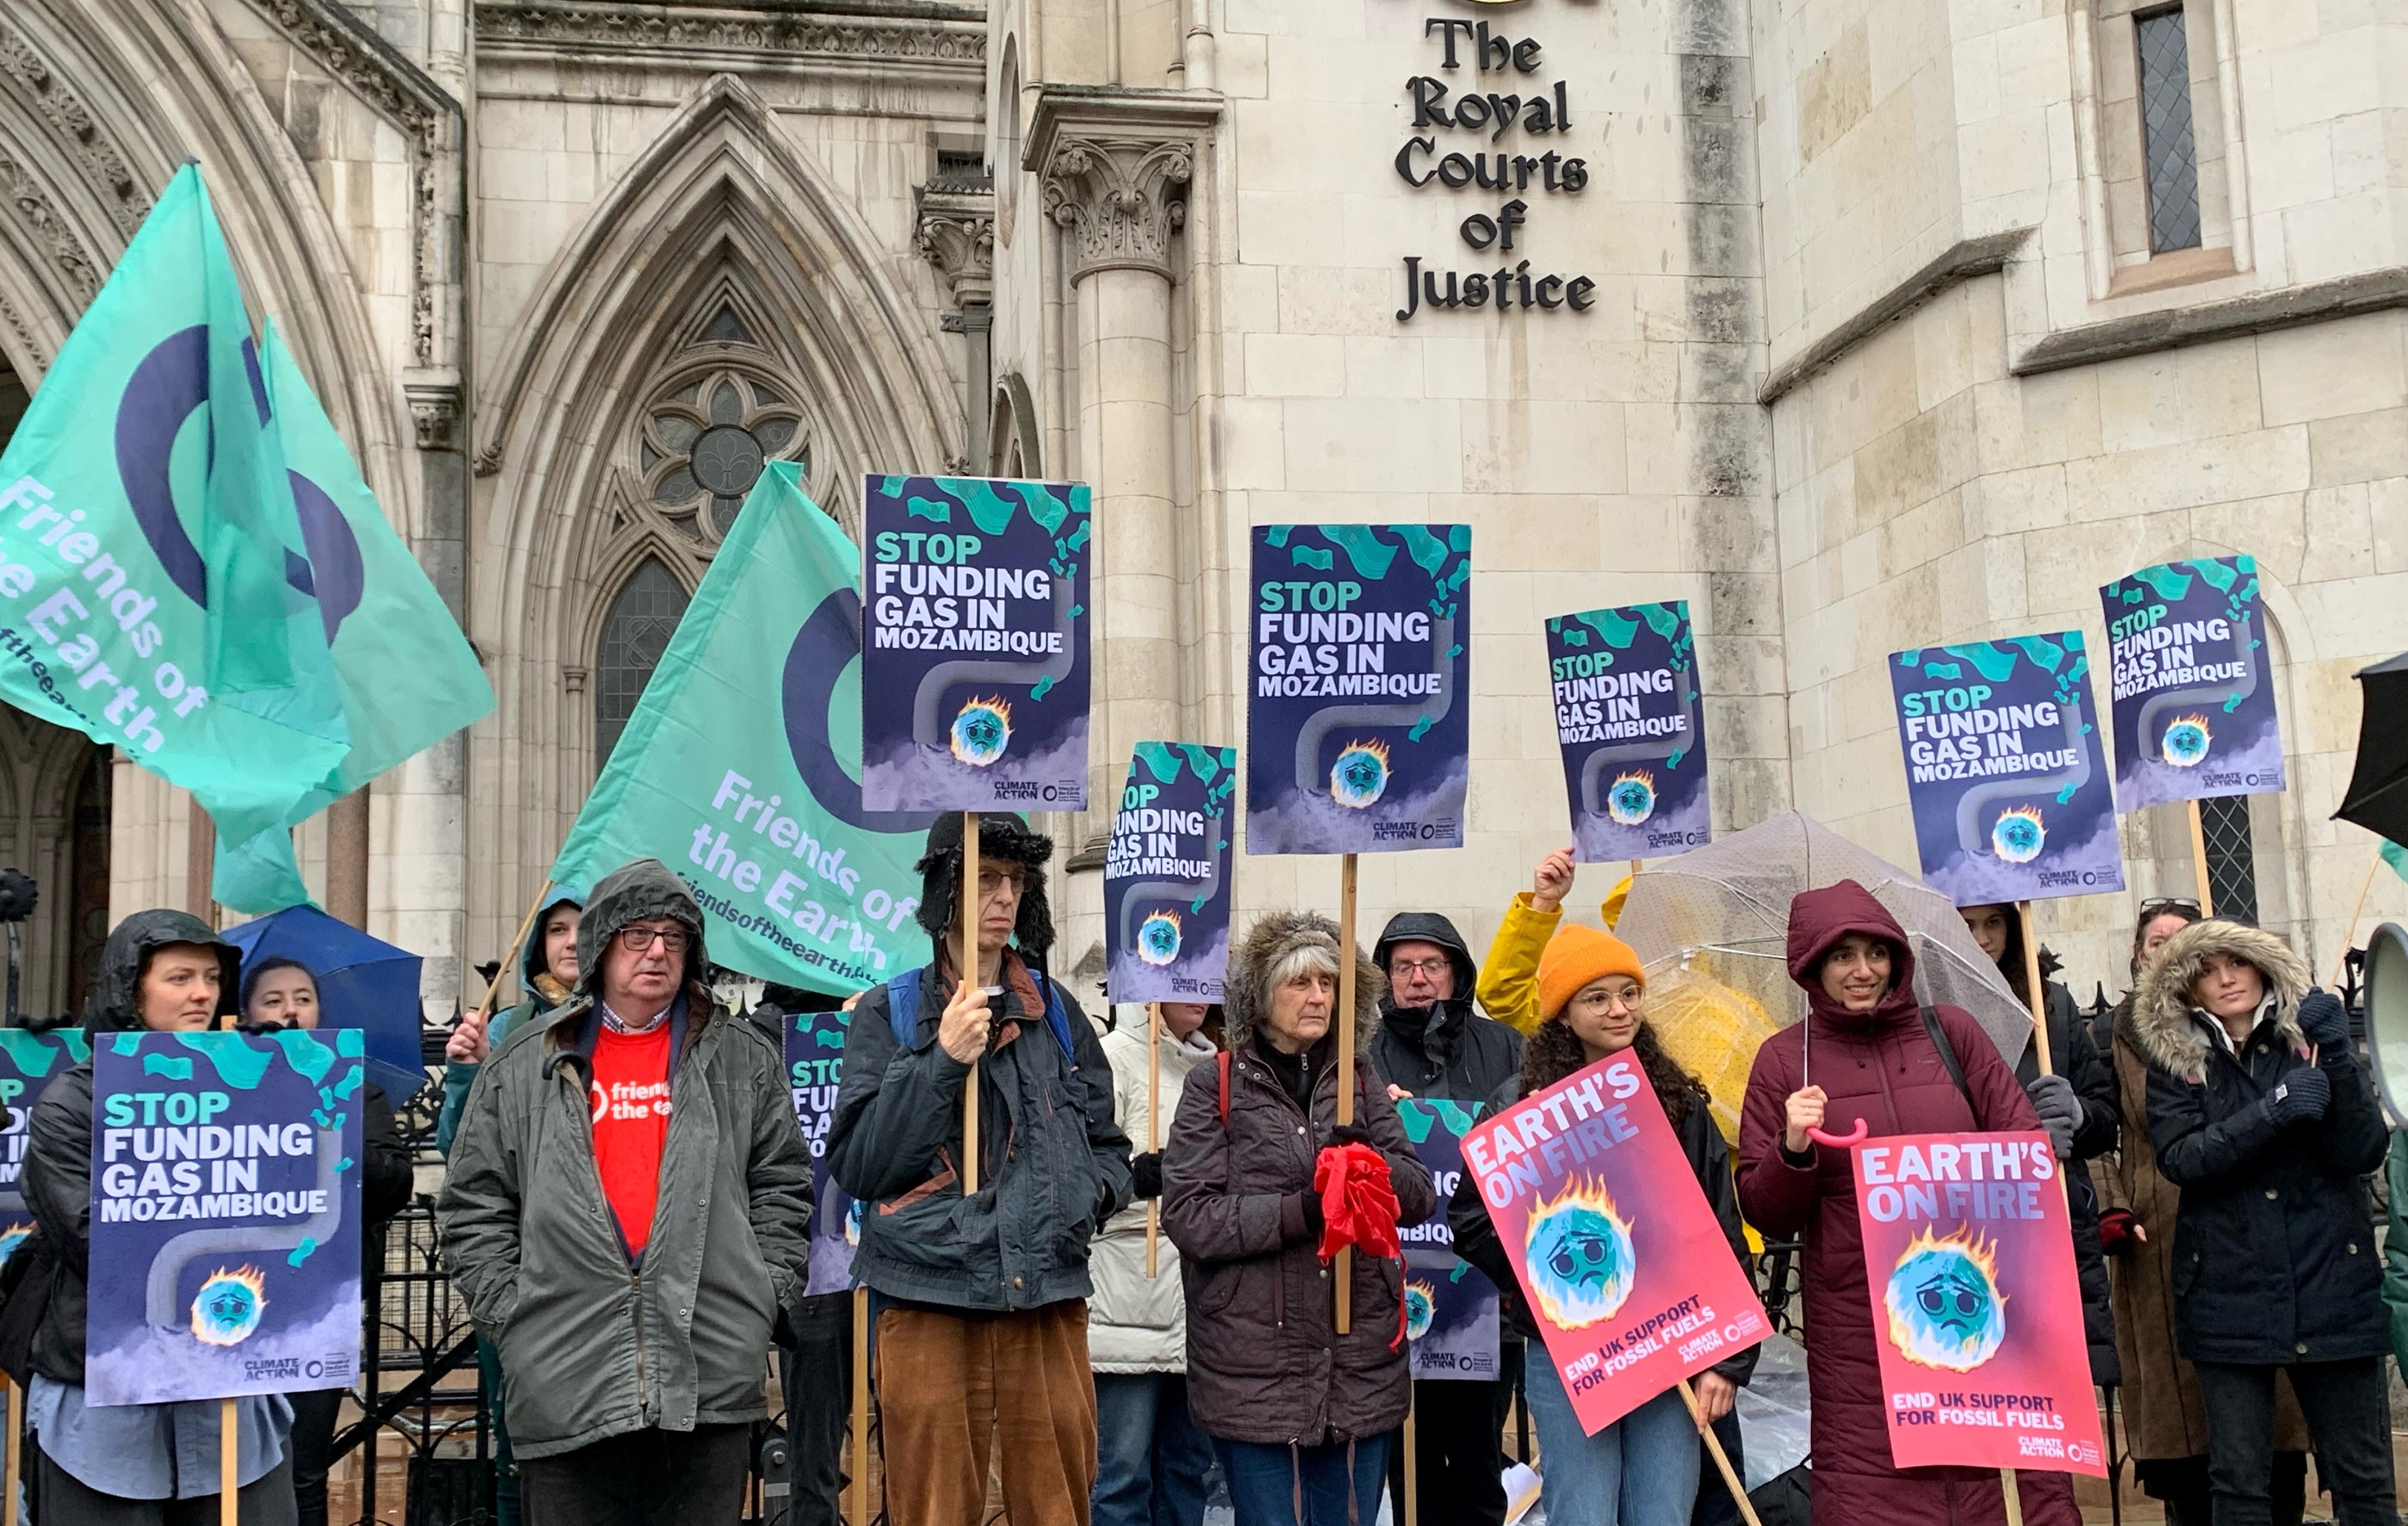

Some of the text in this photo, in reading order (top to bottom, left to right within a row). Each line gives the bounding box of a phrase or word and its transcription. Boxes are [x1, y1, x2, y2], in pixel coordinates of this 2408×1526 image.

[1426, 18, 1542, 73] The
[1406, 76, 1573, 143] Royal
[1395, 136, 1589, 191] Courts
[1460, 199, 1528, 249] of
[1396, 256, 1597, 321] Justice
[875, 532, 981, 565] STOP
[0, 475, 210, 719] Friends of
[875, 564, 1050, 600] FUNDING
[1259, 582, 1361, 612] STOP
[875, 597, 1005, 630] GAS IN
[1259, 612, 1429, 644] FUNDING
[2111, 604, 2167, 643] STOP
[875, 628, 1063, 655] MOZAMBIQUE
[2113, 619, 2230, 665] FUNDING
[26, 586, 164, 752] Earth
[1259, 644, 1384, 675] GAS IN
[1553, 651, 1614, 681] STOP
[2114, 644, 2195, 685] GAS IN
[1258, 673, 1442, 698] MOZAMBIQUE
[1554, 669, 1673, 705] FUNDING
[2114, 662, 2247, 702] MOZAMBIQUE
[1557, 696, 1640, 728] GAS IN
[1902, 685, 1991, 716] STOP
[1560, 714, 1687, 744] MOZAMBIQUE
[1905, 702, 2059, 742] FUNDING
[1910, 730, 2023, 766] GAS IN
[1913, 749, 2079, 783] MOZAMBIQUE
[2203, 772, 2241, 781] CLIMATE
[994, 790, 1037, 799] ACTION
[995, 781, 1038, 790] CLIMATE
[1120, 784, 1159, 811] OP
[2203, 780, 2242, 789] ACTION
[1373, 822, 1417, 830] CLIMATE
[1373, 831, 1417, 840] ACTION
[1648, 831, 1683, 841] CLIMATE
[712, 768, 919, 932] Friends of
[1108, 834, 1176, 862] GAS IN
[1649, 839, 1683, 849] ACTION
[1106, 858, 1211, 880] MOZAMBIQUE
[2038, 870, 2078, 879] CLIMATE
[2040, 878, 2079, 888] ACTION
[688, 823, 887, 969] the Earth
[1172, 985, 1197, 993] ACTION
[103, 1091, 229, 1127] STOP
[611, 1101, 649, 1120] the
[1466, 1062, 1640, 1178] EARTH'S
[103, 1123, 312, 1163] FUNDING
[1485, 1158, 1544, 1209] ON
[1539, 1102, 1640, 1178] FIRE
[102, 1159, 257, 1198] GAS IN
[1861, 1141, 2054, 1185] EARTH'S
[101, 1189, 327, 1223] MOZAMBIQUE
[1867, 1182, 2044, 1223] ON FIRE
[1564, 1352, 1599, 1382] END
[1598, 1338, 1625, 1361] UK
[1624, 1294, 1702, 1346] SUPPORT
[1572, 1368, 1606, 1397] FOR
[1604, 1339, 1664, 1378] FOSSIL
[1661, 1306, 1716, 1344] FUELS
[1678, 1328, 1719, 1355] CLIMATE
[1683, 1335, 1724, 1364] ACTION
[244, 1368, 299, 1381] ACTION
[245, 1358, 299, 1369] CLIMATE
[1421, 1360, 1455, 1369] ACTION
[1893, 1392, 2054, 1412] END UK SUPPORT
[1896, 1410, 2064, 1431] FOR FOSSIL FUELS
[2019, 1436, 2063, 1448] CLIMATE
[2020, 1445, 2065, 1458] ACTION
